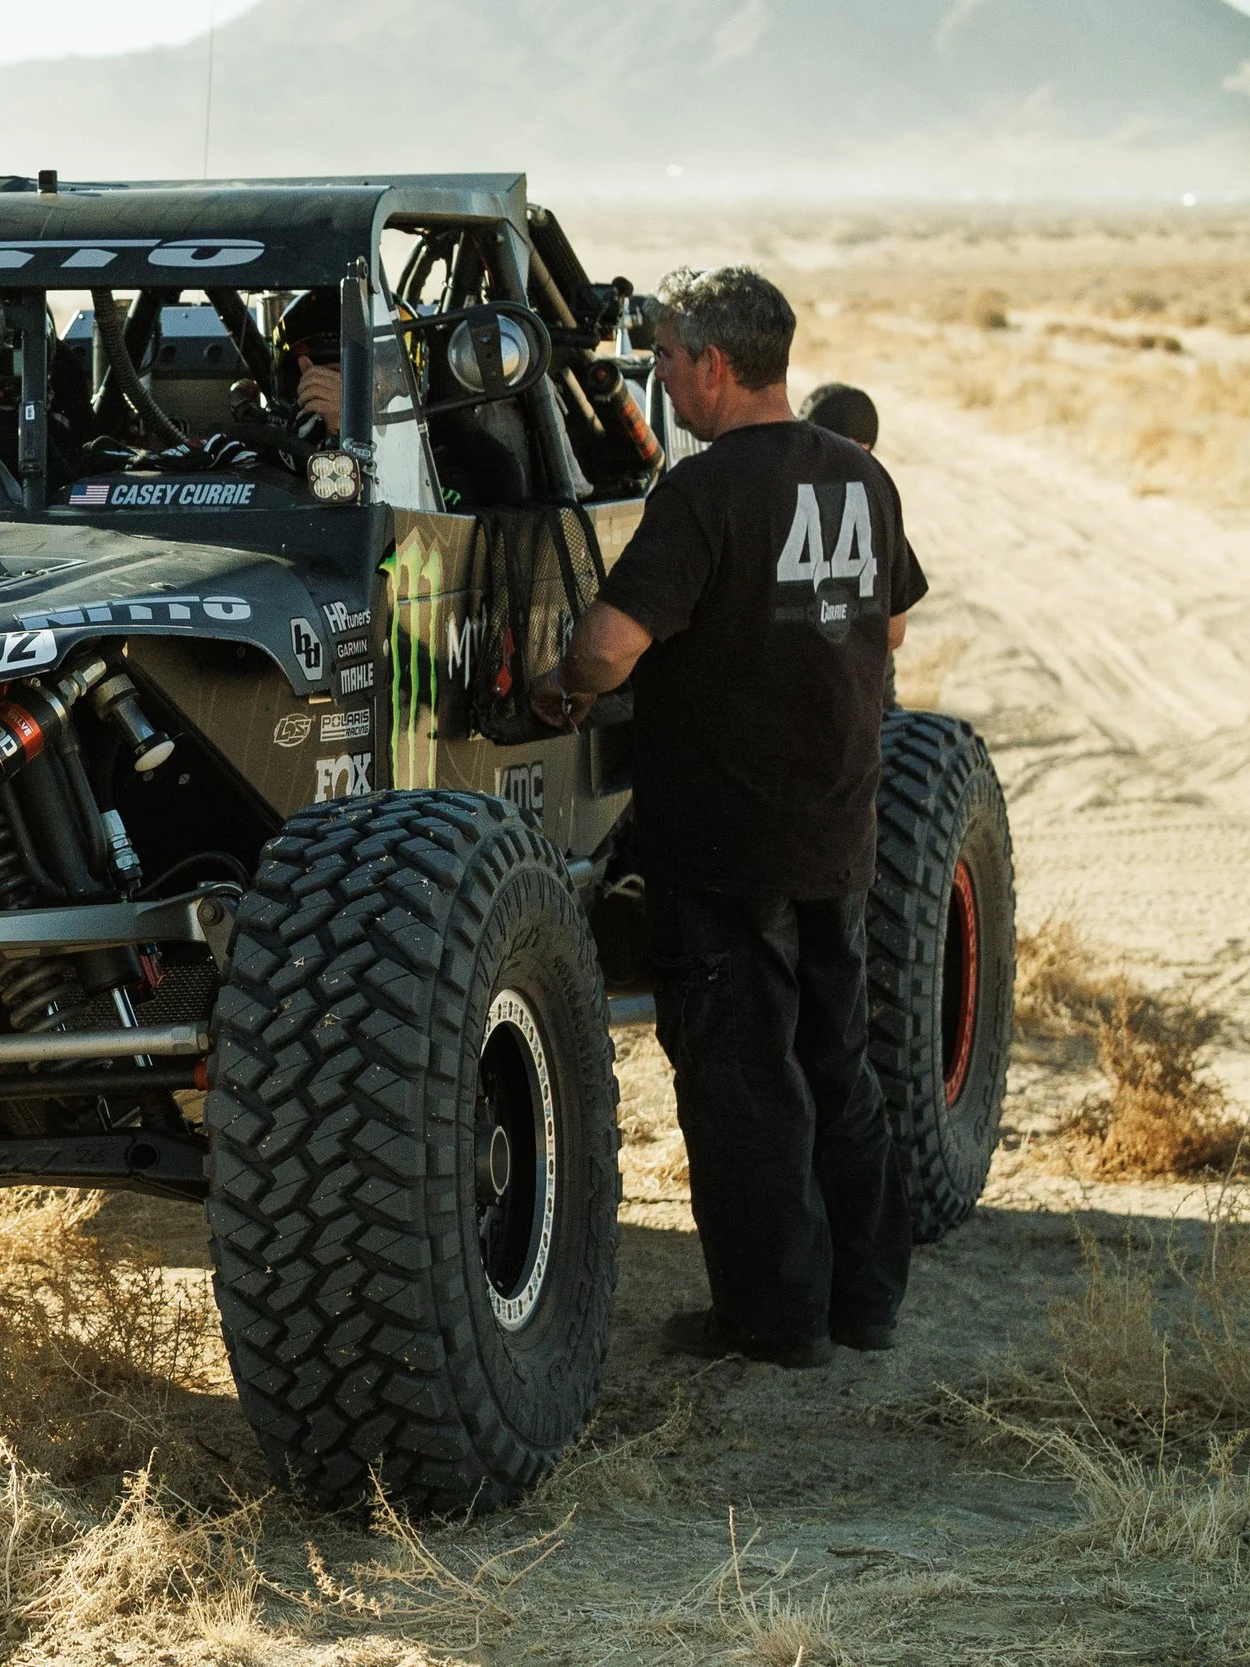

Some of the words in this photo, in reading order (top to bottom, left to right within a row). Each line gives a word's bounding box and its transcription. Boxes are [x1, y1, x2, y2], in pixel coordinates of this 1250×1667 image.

[111, 484, 180, 505] CASEY
[178, 484, 255, 504] CURRIE
[777, 481, 878, 598] 44
[17, 596, 251, 630] NITTO
[337, 639, 368, 658] GARMIN
[341, 662, 374, 695] MAHLE
[321, 708, 370, 728] POLARIS
[345, 724, 370, 738] RACING
[314, 752, 372, 803] FOX
